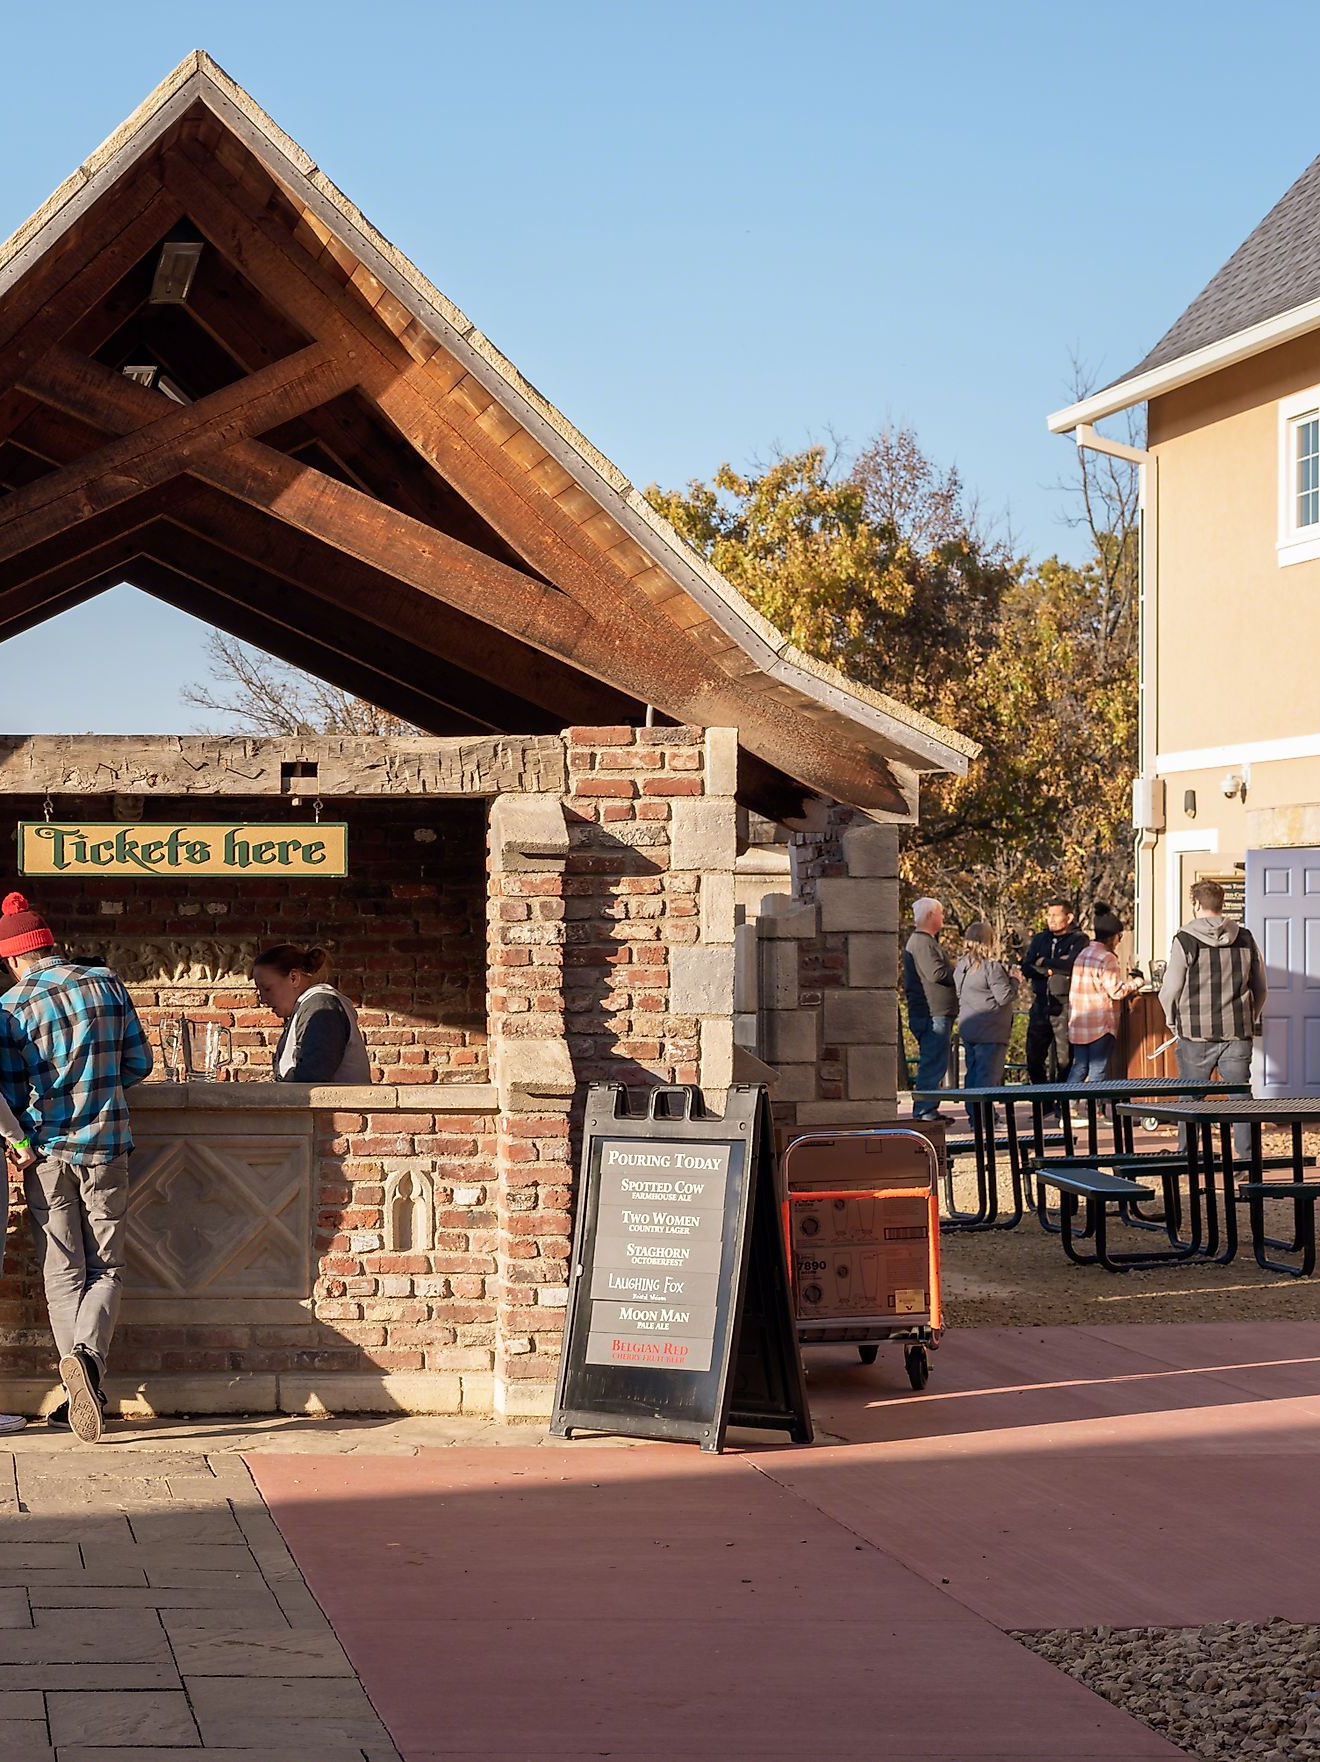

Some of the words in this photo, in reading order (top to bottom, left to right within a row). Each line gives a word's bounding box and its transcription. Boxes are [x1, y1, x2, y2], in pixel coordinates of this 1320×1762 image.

[34, 827, 211, 874] Tickets
[223, 827, 327, 868] here
[608, 1150, 671, 1168] POURING
[674, 1153, 722, 1171] TODAY
[621, 1178, 673, 1193] SPOTTED
[674, 1181, 705, 1195] COW
[632, 1192, 677, 1201] FARMHOUSE
[678, 1194, 692, 1202] ALE
[622, 1210, 650, 1224] TWO
[652, 1212, 701, 1227] WOMEN
[629, 1224, 665, 1234] COUNTRY
[665, 1226, 690, 1235] LAGER
[626, 1243, 690, 1259] STAGHORN
[631, 1257, 684, 1267] OCTOBERFEST
[608, 1272, 660, 1291] LAUGHING
[663, 1276, 685, 1294] FOX
[619, 1307, 658, 1321] MOON
[659, 1308, 690, 1323] MAN
[637, 1322, 654, 1330] PALE
[654, 1322, 670, 1331] ALE
[611, 1339, 660, 1354] BELGIAN
[663, 1342, 688, 1356] RED
